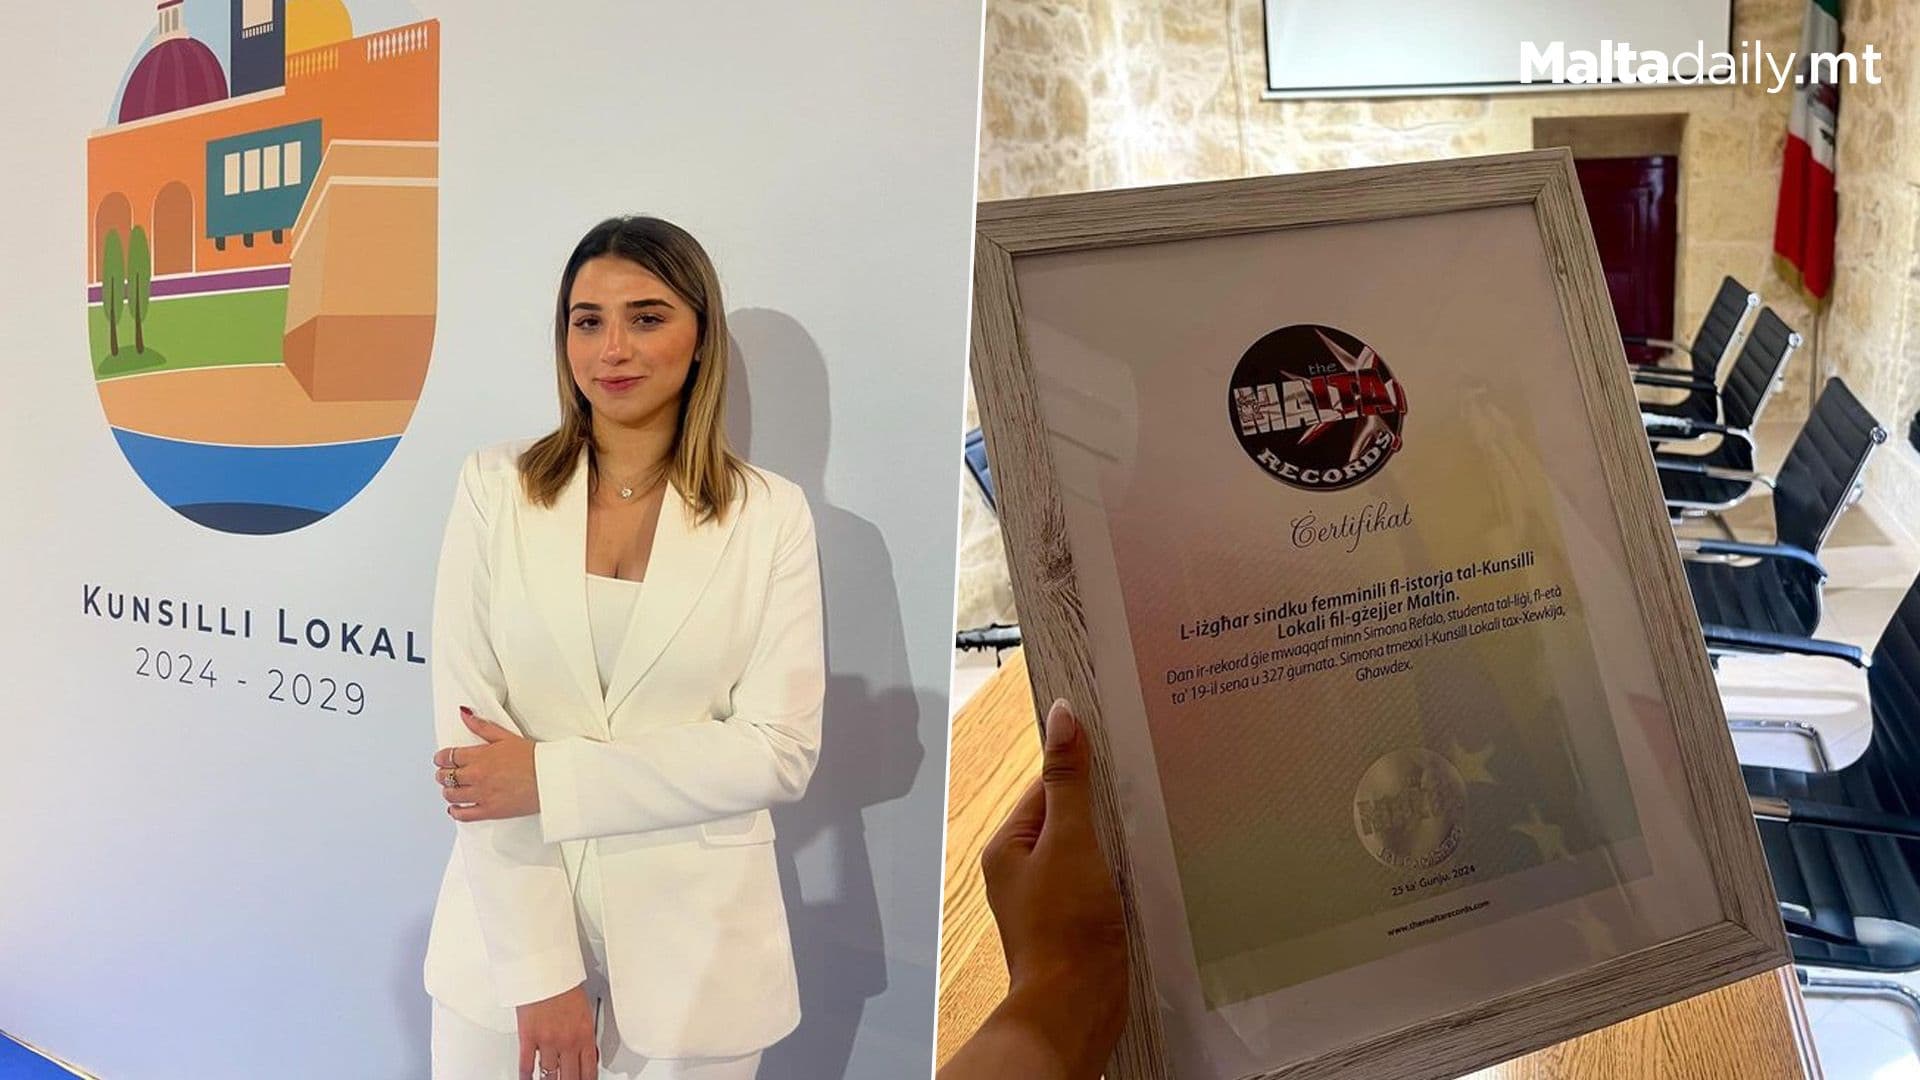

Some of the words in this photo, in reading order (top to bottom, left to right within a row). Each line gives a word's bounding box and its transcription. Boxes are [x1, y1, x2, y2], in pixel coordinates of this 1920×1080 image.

[1308, 361, 1338, 376] the
[1233, 368, 1396, 437] MALTA
[1257, 431, 1395, 484] RECORDS
[83, 583, 251, 639] KUNSILLI
[1254, 601, 1307, 625] sindku
[1311, 582, 1387, 613] femminili
[1390, 571, 1453, 595] fl-istorja
[1457, 551, 1535, 582] tal-Kunsilli
[1278, 614, 1326, 640] Lokali
[1330, 602, 1404, 624] fil-gżejjer
[1407, 588, 1460, 612] Maltin.
[1166, 669, 1194, 685] Dan
[1196, 654, 1249, 677] ir-rekord
[1271, 637, 1330, 662] mwaqqaf
[1331, 630, 1362, 648] minn
[1363, 621, 1408, 641] Simona
[1409, 610, 1446, 630] Refalo,
[1447, 601, 1495, 621] studenta
[1191, 682, 1218, 701] 19-il
[1219, 679, 1249, 694] sena
[1251, 675, 1260, 686] u
[1262, 667, 1284, 685] 327
[1340, 646, 1385, 666] Simona
[1385, 636, 1423, 656] tmexxi
[1469, 617, 1500, 636] Lokali
[135, 646, 218, 688] 2024
[267, 668, 366, 716] 2029
[1391, 886, 1404, 897] 25
[1451, 864, 1476, 879] 2024
